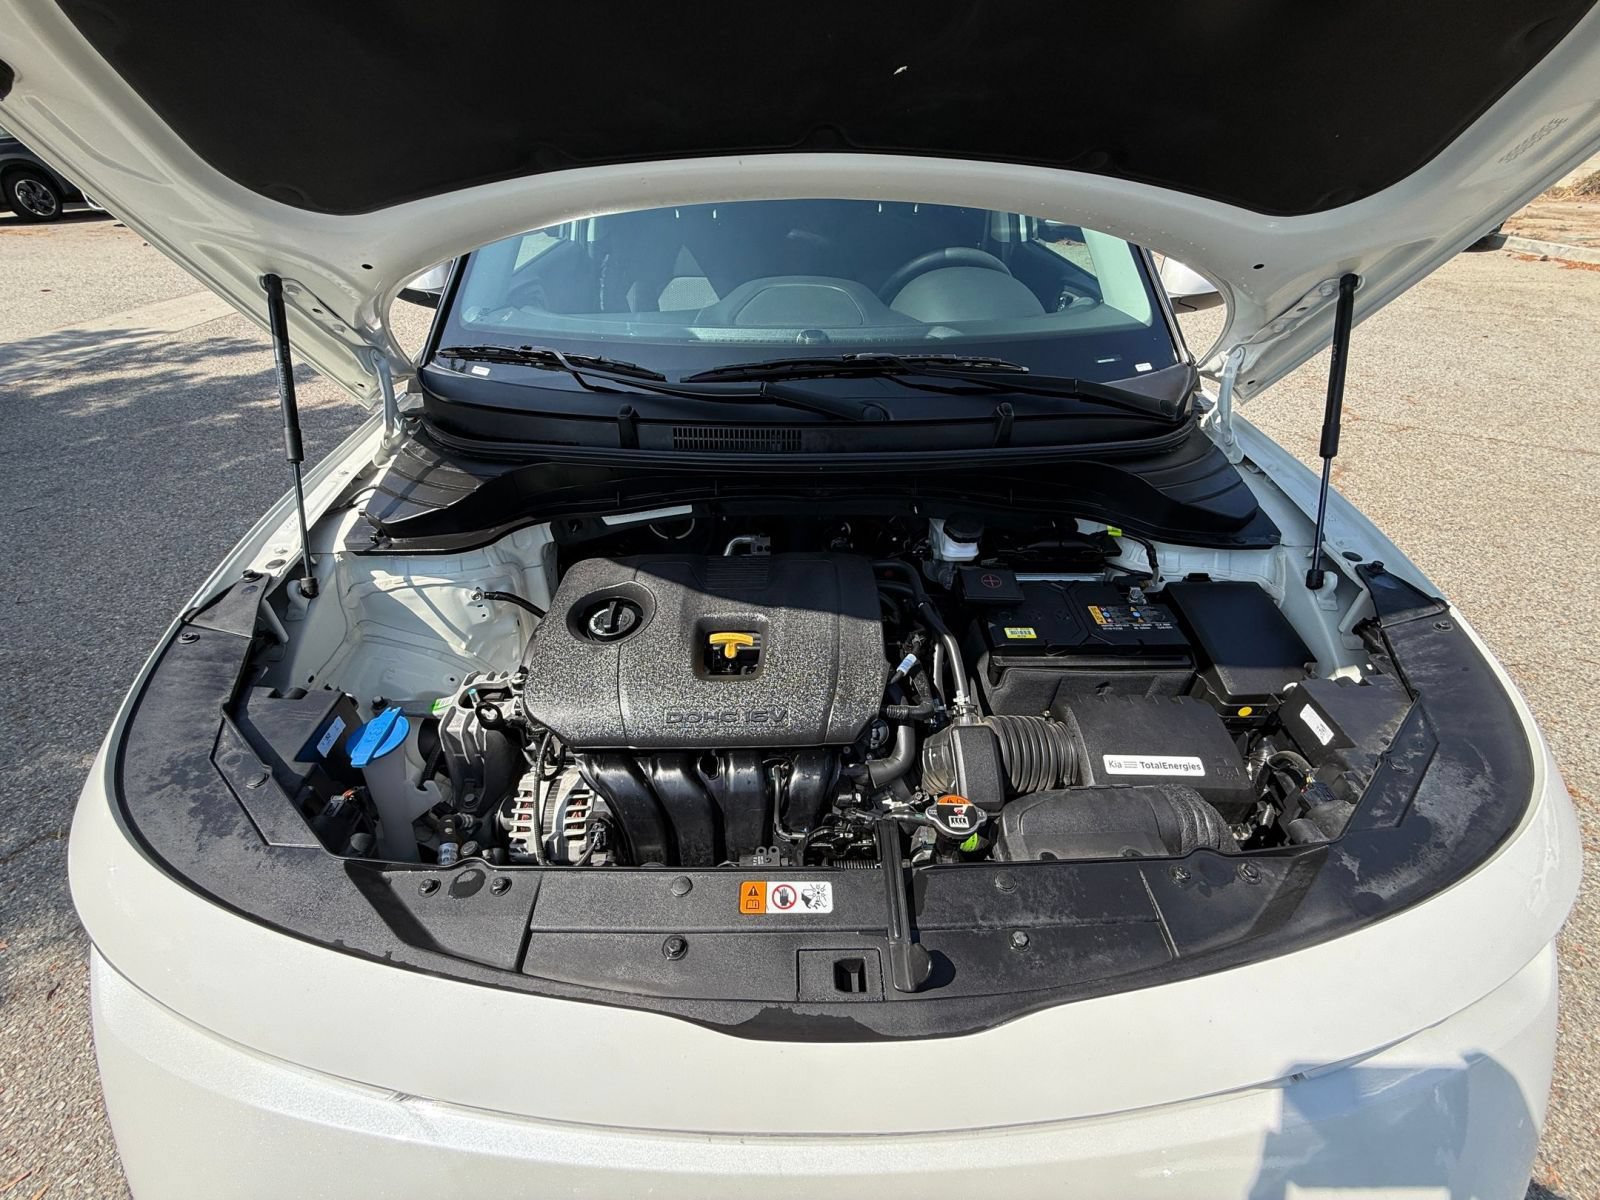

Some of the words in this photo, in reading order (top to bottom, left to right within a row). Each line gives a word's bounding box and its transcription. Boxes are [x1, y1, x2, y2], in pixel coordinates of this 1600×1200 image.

[665, 711, 738, 723] DOHC
[745, 709, 787, 722] 16V
[1108, 760, 1122, 768] Kia
[1140, 761, 1201, 771] TotalEnergies
